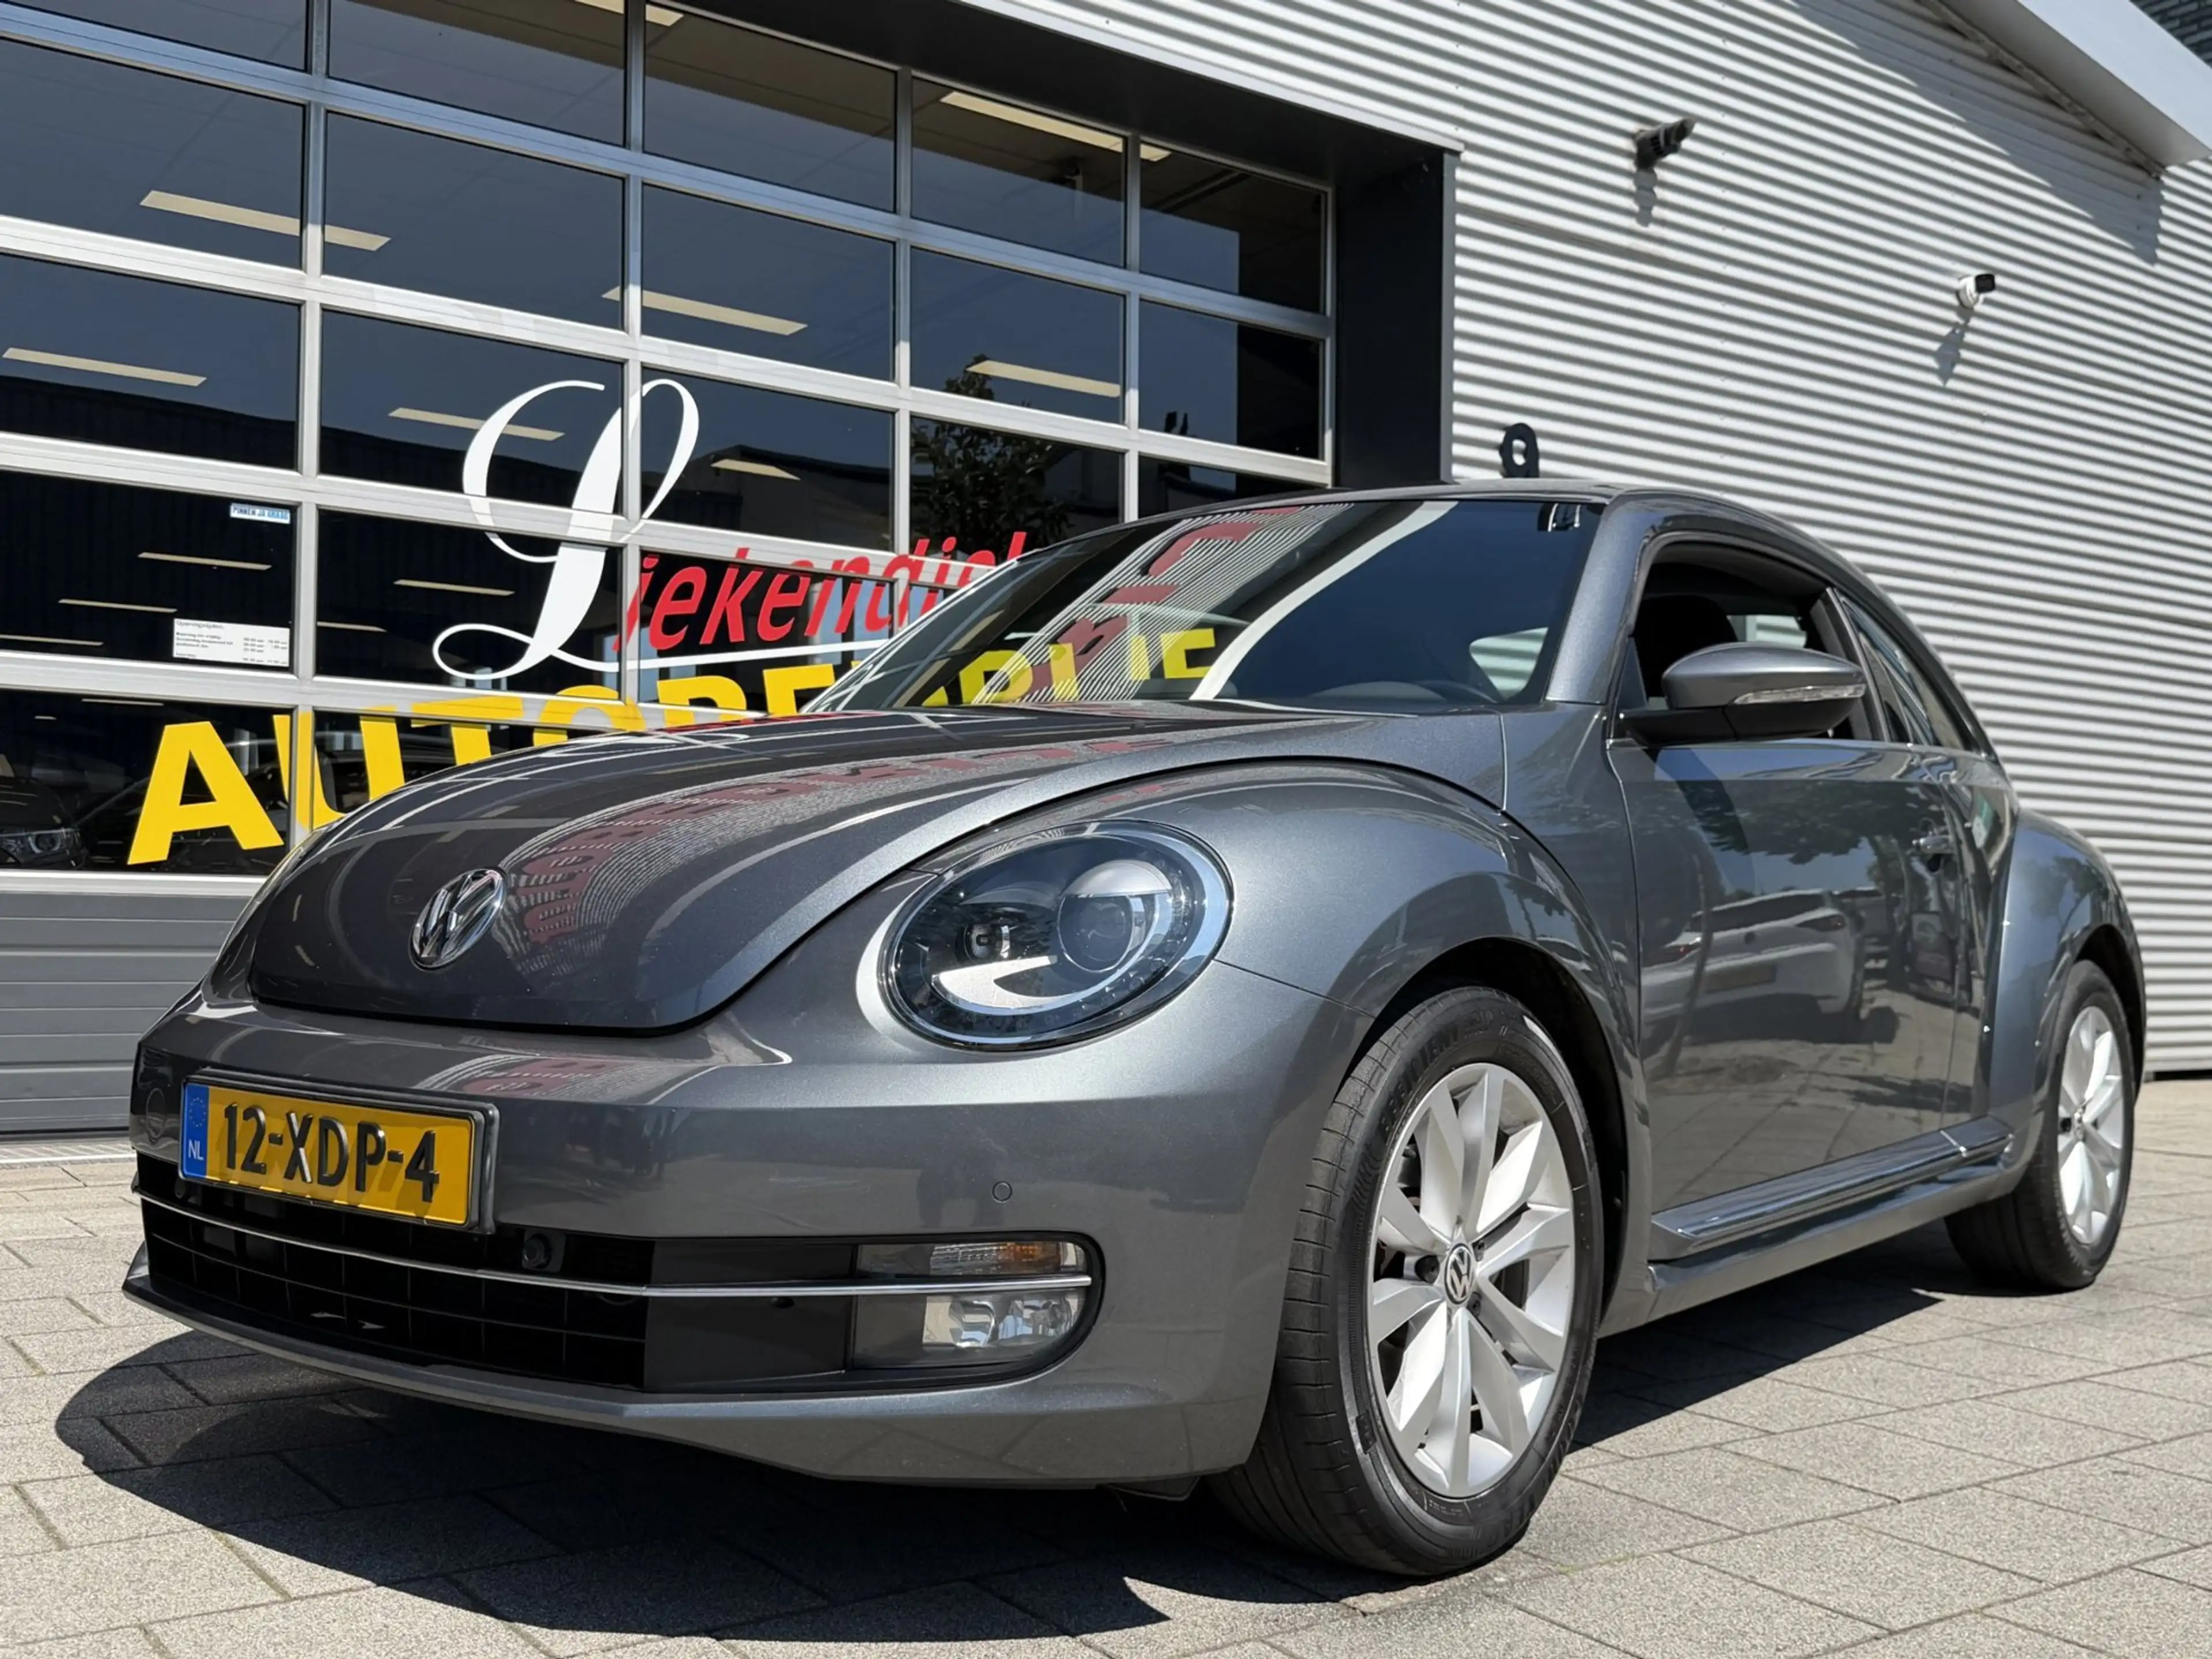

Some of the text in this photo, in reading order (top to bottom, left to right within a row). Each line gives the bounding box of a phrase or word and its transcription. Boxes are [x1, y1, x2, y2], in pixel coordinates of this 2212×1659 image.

[433, 378, 1027, 680] Liekendi
[188, 1138, 204, 1162] NL
[224, 1103, 440, 1203] 12-XDP-4
